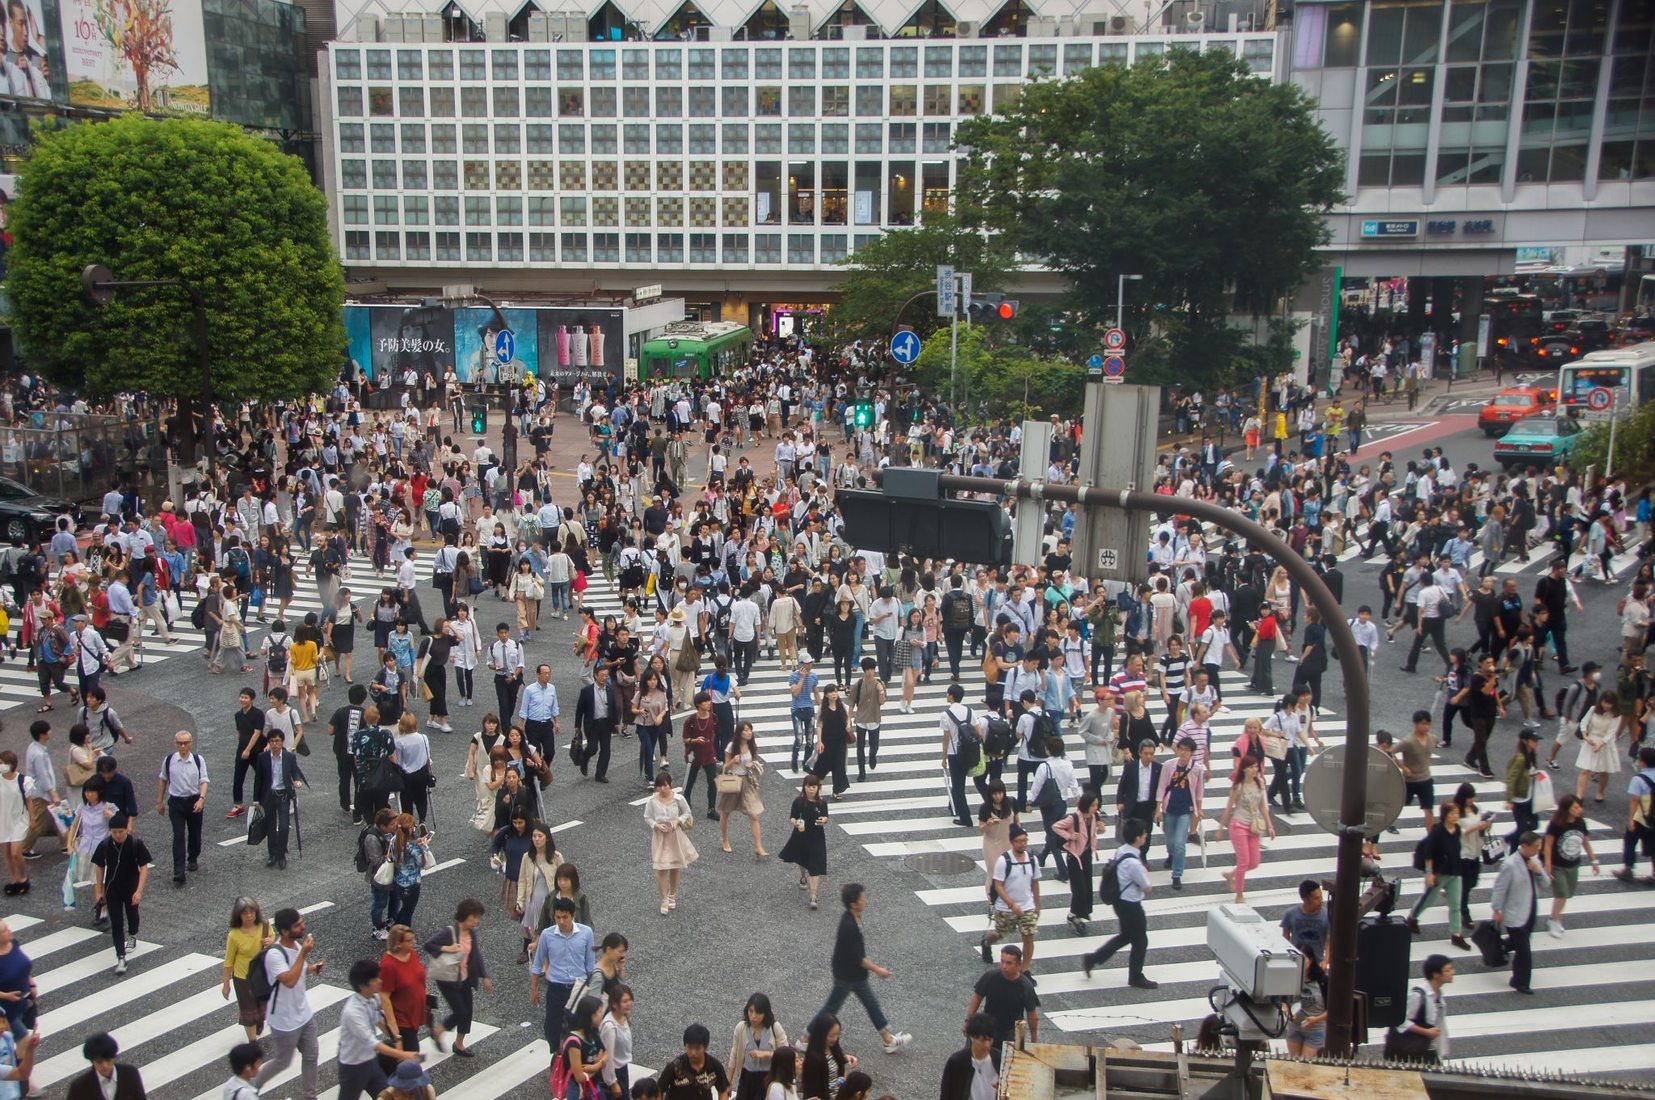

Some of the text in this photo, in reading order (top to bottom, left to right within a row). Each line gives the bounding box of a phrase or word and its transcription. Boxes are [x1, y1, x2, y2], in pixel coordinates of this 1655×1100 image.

[376, 337, 450, 353] 予防美髪の女。
